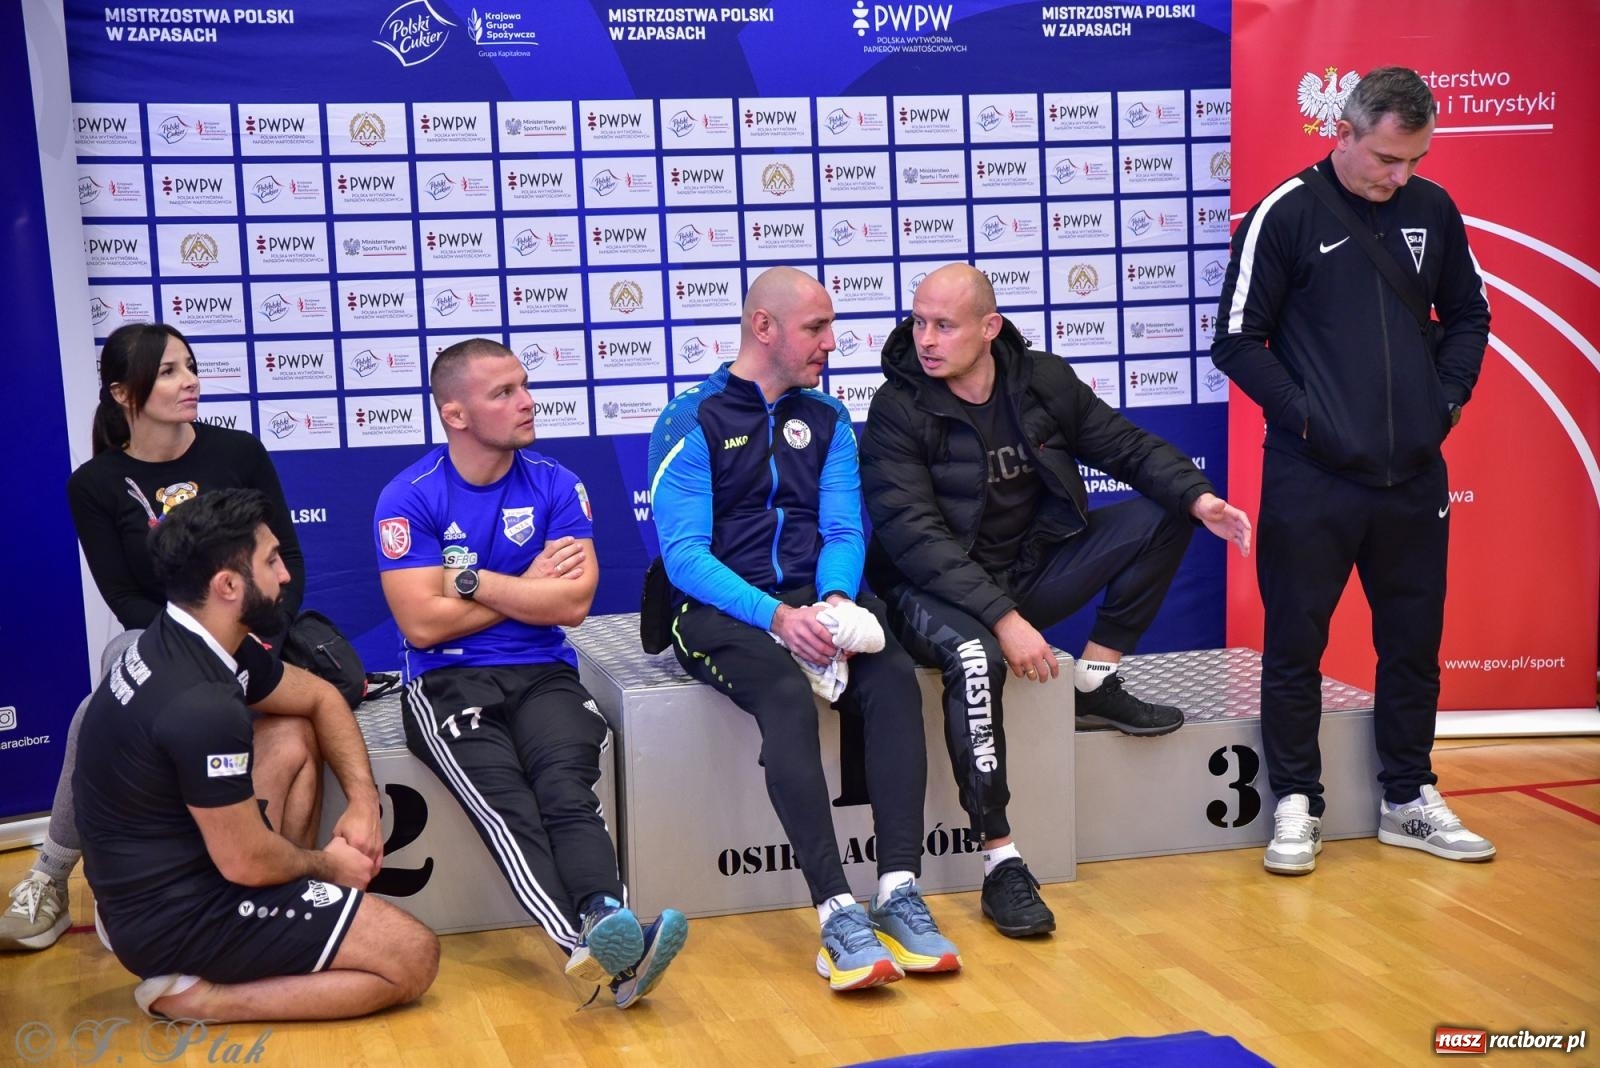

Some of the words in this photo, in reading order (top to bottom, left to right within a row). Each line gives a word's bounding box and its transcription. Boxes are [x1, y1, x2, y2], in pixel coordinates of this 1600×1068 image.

[105, 8, 231, 23] MISTRZOSTWA
[234, 9, 295, 24] POLSKI
[485, 12, 521, 22] Krajowa
[609, 8, 718, 23] MISTRZOSTWA
[721, 8, 774, 22] POLSKI
[875, 5, 953, 32] PWPW
[1042, 5, 1143, 20] MISTRZOSTWA
[1146, 4, 1196, 18] POLSKI
[389, 16, 430, 41] Polski
[486, 21, 514, 31] Grupa
[609, 27, 625, 40] W
[628, 26, 706, 40] ZAPASACH
[1042, 23, 1057, 37] W
[1059, 22, 1131, 37] ZAPASACH
[106, 27, 125, 41] W
[127, 27, 217, 43] ZAPASACH
[486, 30, 536, 40] Spożywcza
[877, 36, 905, 44] POLSKA
[907, 35, 953, 44] WYTWÓRNIA
[400, 31, 443, 54] Cukier
[864, 45, 901, 53] PAPIERÓW
[902, 44, 967, 53] WARTOŚCIOWYCH
[478, 50, 497, 58] Grupa
[498, 49, 531, 58] Kapitałowa
[1419, 69, 1511, 89] sterstwo
[1447, 95, 1453, 114] i
[1459, 92, 1556, 117] Turystyki
[756, 111, 796, 125] PWPW
[911, 109, 949, 122] PWPW
[1060, 105, 1098, 119] PWPW
[78, 117, 127, 132] PWPW
[259, 118, 304, 132] PWPW
[433, 116, 476, 130] PWPW
[600, 114, 641, 128] PWPW
[988, 162, 1026, 176] PWPW
[1135, 157, 1172, 171] PWPW
[520, 173, 562, 187] PWPW
[683, 169, 723, 183] PWPW
[836, 166, 876, 180] PWPW
[176, 179, 222, 192] PWPW
[350, 176, 394, 190] PWPW
[915, 219, 953, 233] PWPW
[1064, 214, 1102, 228] PWPW
[605, 228, 646, 242] PWPW
[764, 224, 804, 238] PWPW
[89, 239, 137, 254] PWPW
[269, 237, 314, 251] PWPW
[439, 233, 482, 247] PWPW
[991, 271, 1030, 285] PWPW
[1138, 265, 1175, 279] PWPW
[688, 282, 728, 296] PWPW
[842, 277, 883, 290] PWPW
[360, 293, 404, 308] PWPW
[526, 288, 567, 302] PWPW
[92, 305, 101, 314] lski
[186, 298, 232, 312] PWPW
[1067, 322, 1104, 336] PWPW
[610, 342, 651, 356] PWPW
[278, 354, 324, 368] PWPW
[1141, 371, 1178, 385] PWPW
[848, 385, 878, 400] PWP
[535, 401, 576, 416] PWPW
[198, 415, 237, 428] WPW
[369, 409, 412, 423] PWPW
[724, 435, 748, 450] JAKO
[1085, 479, 1133, 493] PASA
[291, 508, 327, 524] LSKI
[633, 507, 650, 521] W
[1086, 663, 1111, 672] PUMA
[1444, 655, 1566, 672] www.gov.pl/sport
[957, 638, 998, 773] WRESTLING
[0, 735, 51, 750] araciborz
[1206, 744, 1262, 829] 3
[367, 783, 434, 898] 2
